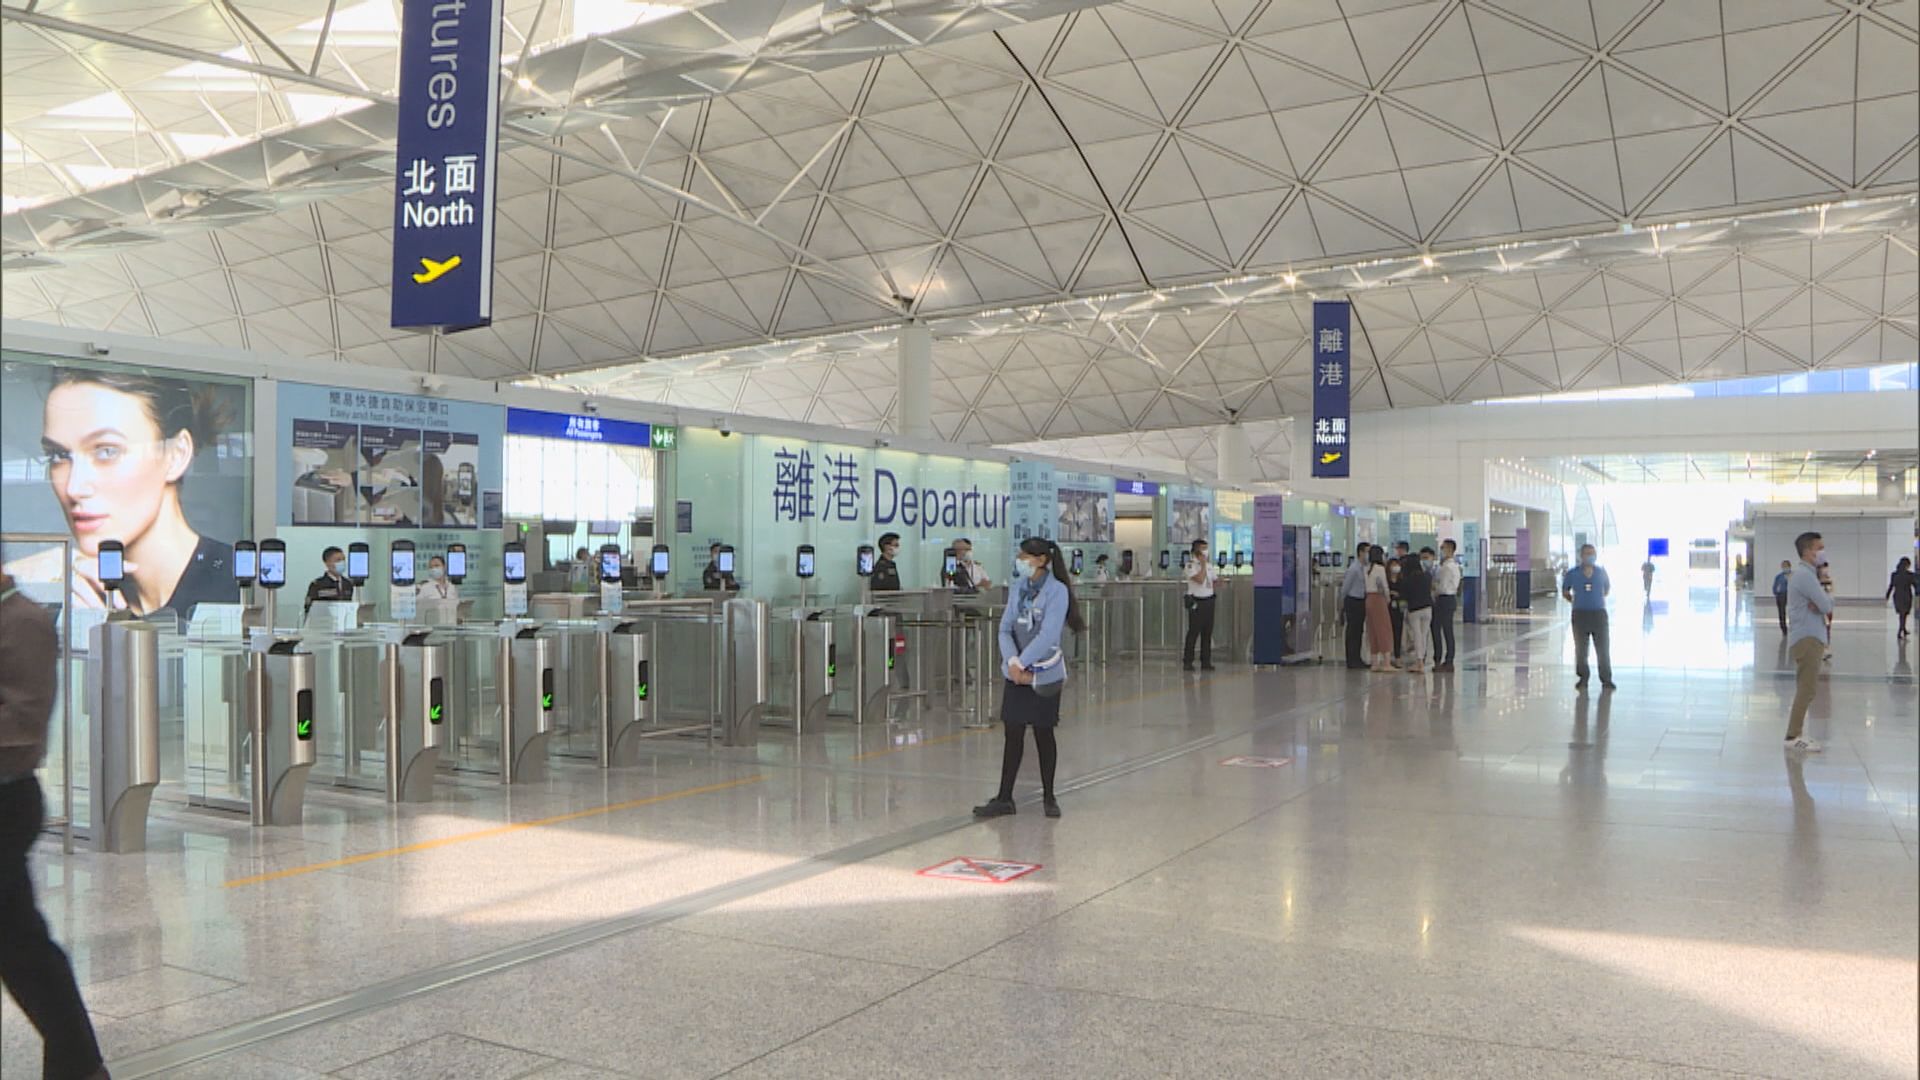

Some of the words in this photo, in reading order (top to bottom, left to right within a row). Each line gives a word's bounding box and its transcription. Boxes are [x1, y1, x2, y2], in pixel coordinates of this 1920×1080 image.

[427, 0, 467, 129] tures
[403, 154, 478, 196] 北面
[403, 198, 474, 229] North
[1319, 328, 1344, 386] 離港
[1315, 418, 1346, 433] 北面
[1316, 433, 1346, 444] North
[773, 446, 860, 522] 離港
